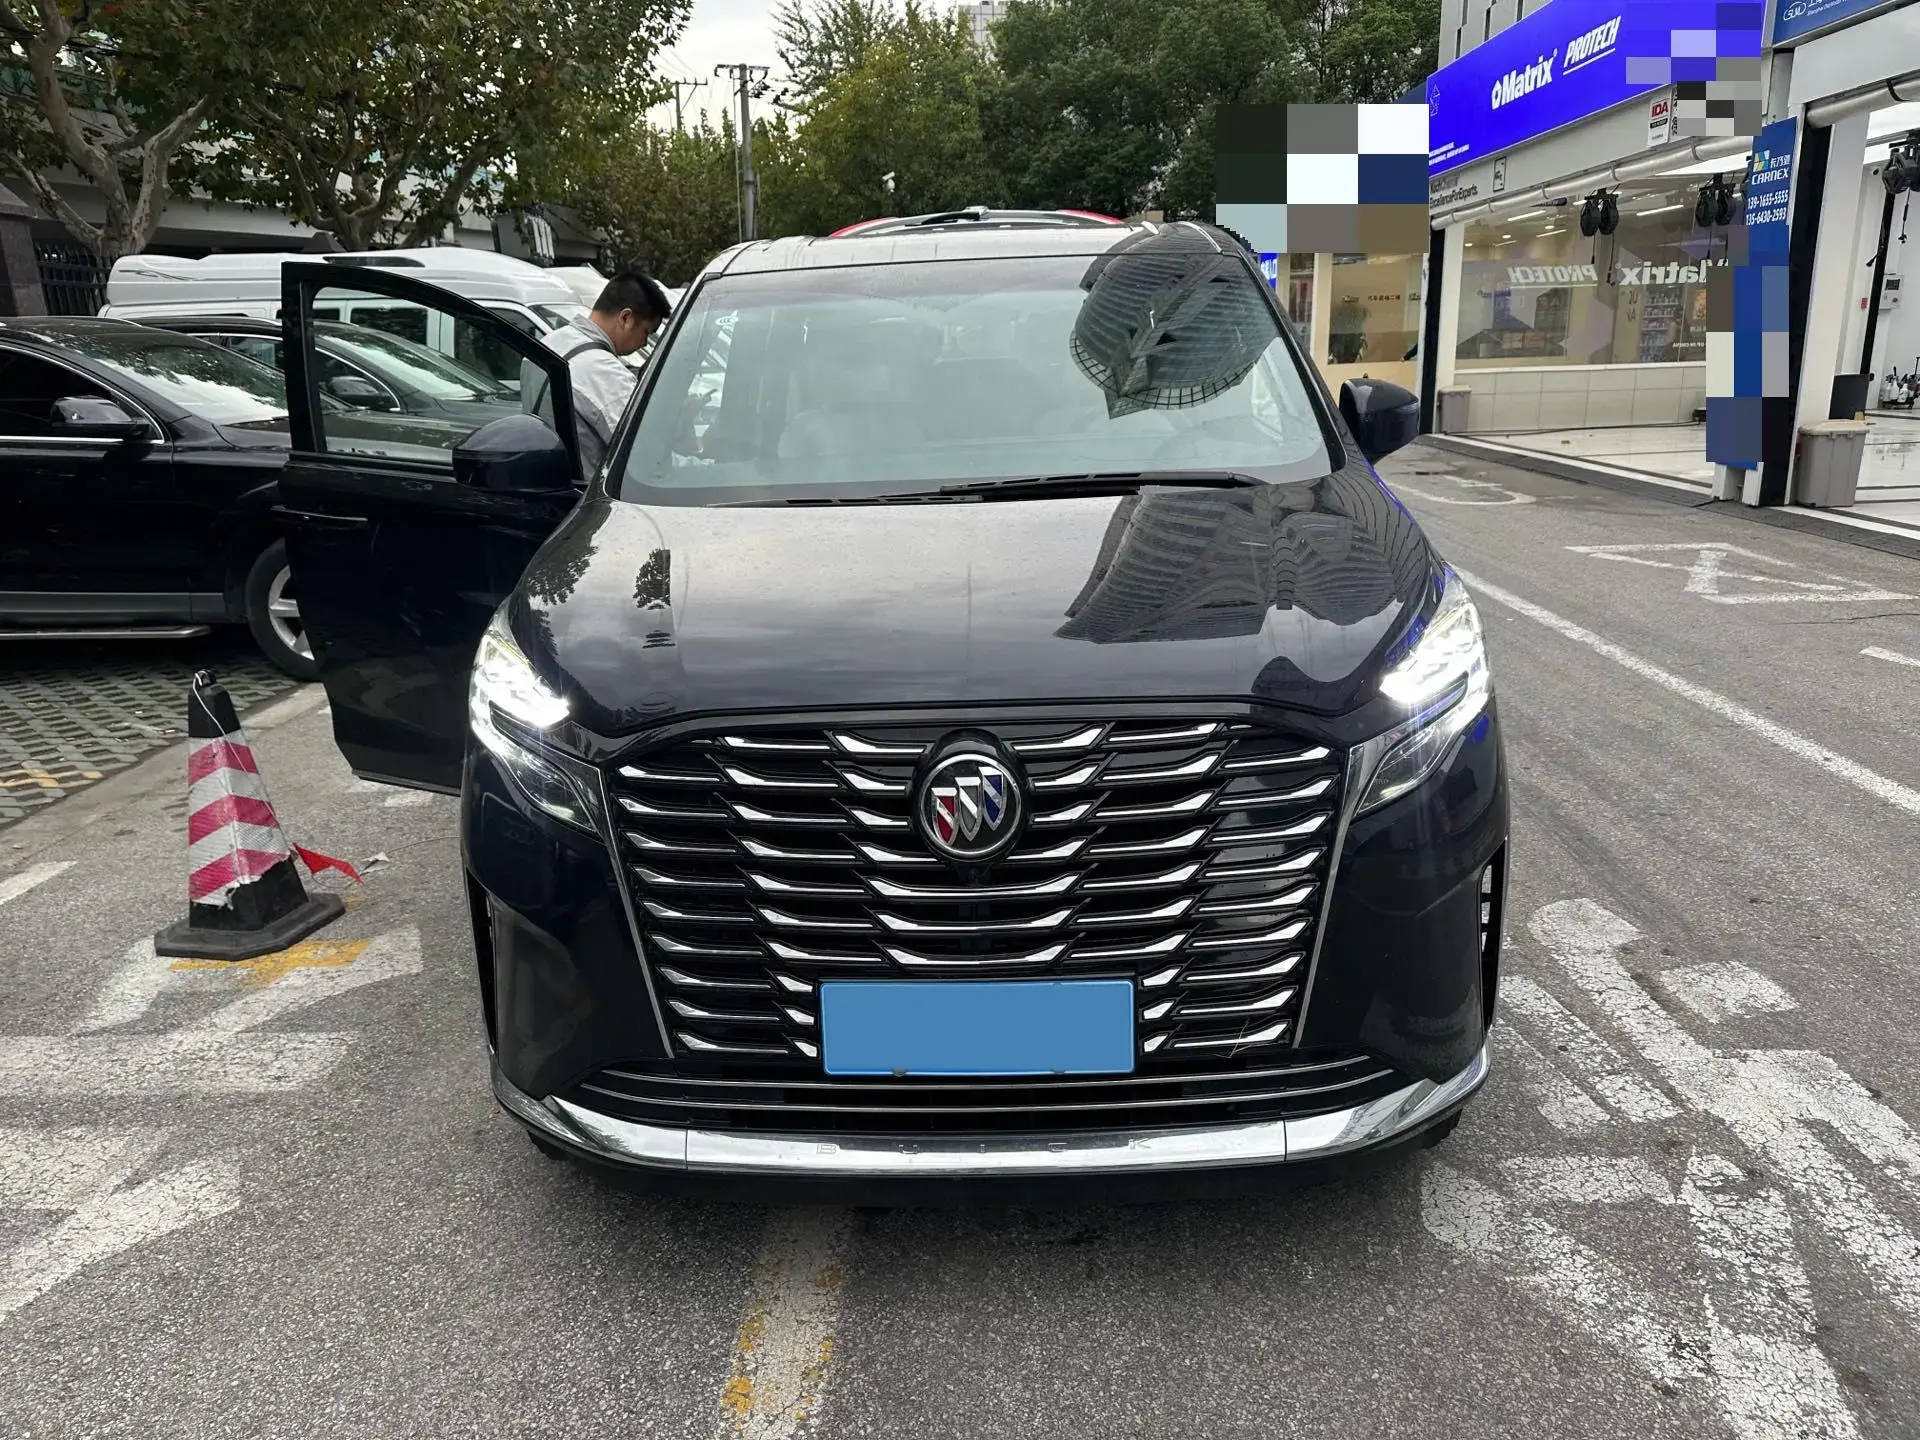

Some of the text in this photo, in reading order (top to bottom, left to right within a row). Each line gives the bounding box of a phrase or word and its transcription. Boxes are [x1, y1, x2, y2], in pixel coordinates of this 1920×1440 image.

[1500, 15, 1622, 106] Matrix PROTECH
[1651, 101, 1668, 117] IDA
[1752, 167, 1789, 185] CARNEX
[1748, 190, 1789, 209] 139-1655-5555
[816, 1138, 1152, 1154] BUICK
